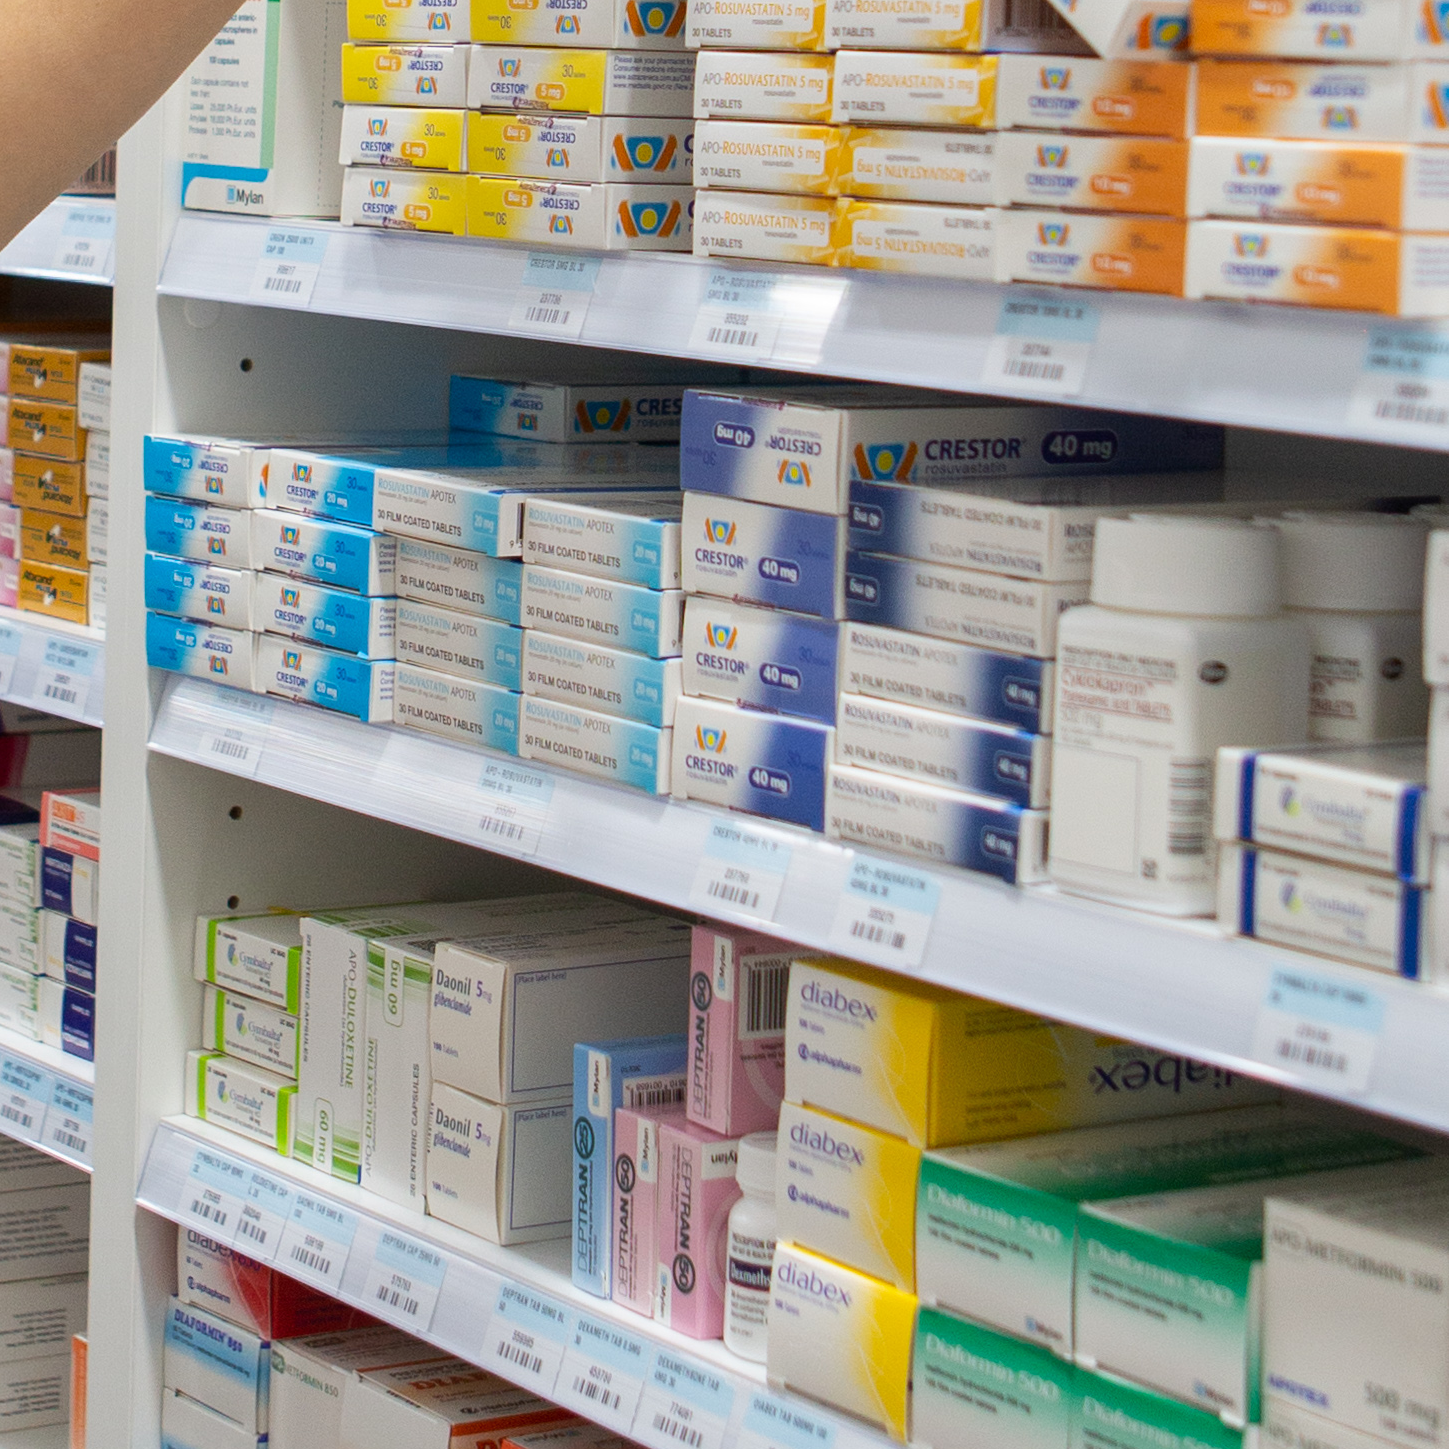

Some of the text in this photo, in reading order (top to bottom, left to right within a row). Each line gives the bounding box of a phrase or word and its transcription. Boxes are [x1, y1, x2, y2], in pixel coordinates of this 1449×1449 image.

[693, 2, 810, 20] APO-ROSUVASTATIN mg
[562, 64, 574, 78] 30
[703, 73, 824, 91] APO-ROSUVASTATIN mg
[491, 82, 526, 94] CRESTOR
[548, 87, 561, 100] mg
[412, 143, 424, 156] mg
[236, 185, 264, 205] Mylan
[543, 198, 580, 210] CRESTOR
[702, 211, 825, 233] APO-ROSUVASTATIN mg
[716, 424, 822, 455] CRESTOR 40 mg
[925, 435, 1112, 462] CRESTOR 40 mg
[286, 485, 316, 500] CRESTOR
[378, 477, 457, 505] ROSUVASTATIN APOTEX
[387, 509, 462, 537] FILM COATED TABLETS
[452, 555, 479, 573] APOTEX
[694, 548, 797, 582] CRESTOR 40 mg
[276, 671, 306, 687] CRESTOR
[582, 717, 612, 735] APOTEX
[534, 736, 617, 769] FILM COATED TABLETS
[436, 968, 471, 997] Daonil
[800, 980, 876, 1023] diabex
[693, 976, 709, 1115] DEPTRAN 50
[318, 1108, 330, 1133] 60
[435, 1107, 471, 1137] Daonil
[577, 1123, 592, 1149] 25
[789, 1121, 863, 1166] diabex
[676, 1146, 693, 1290] DEPTRAN 50
[174, 1308, 227, 1342] DIAFORMIN
[324, 1379, 339, 1398] 850
